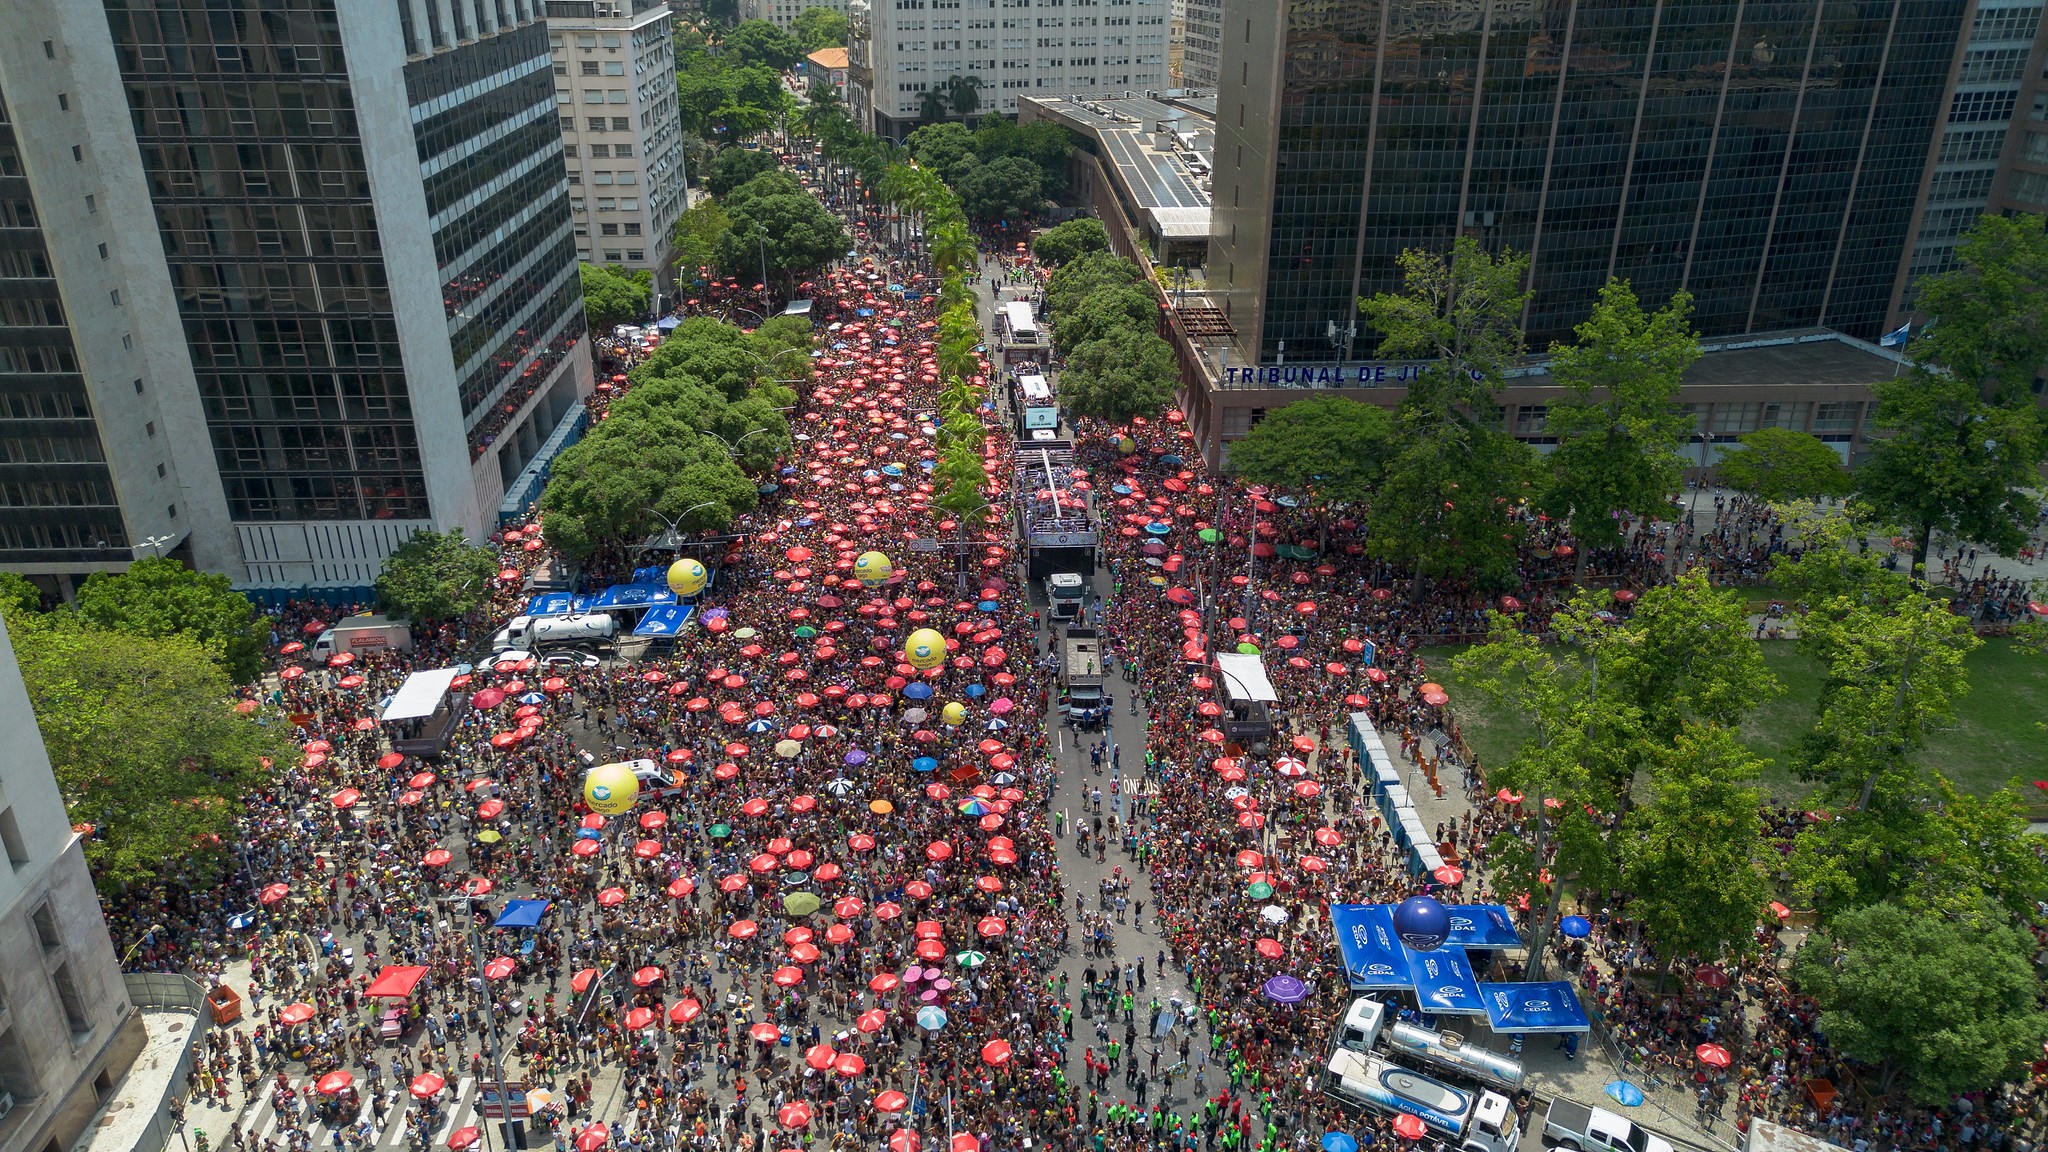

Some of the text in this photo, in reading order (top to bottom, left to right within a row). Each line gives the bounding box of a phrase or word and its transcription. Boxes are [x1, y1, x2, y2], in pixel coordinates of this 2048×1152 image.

[1226, 366, 1346, 384] TRIBUNAL
[1358, 366, 1386, 382] DE
[912, 656, 937, 664] mercado
[1123, 773, 1160, 795] ÔNIUS
[587, 798, 618, 808] mercado
[1398, 1102, 1450, 1128] ÁGUA POTÁVEL
